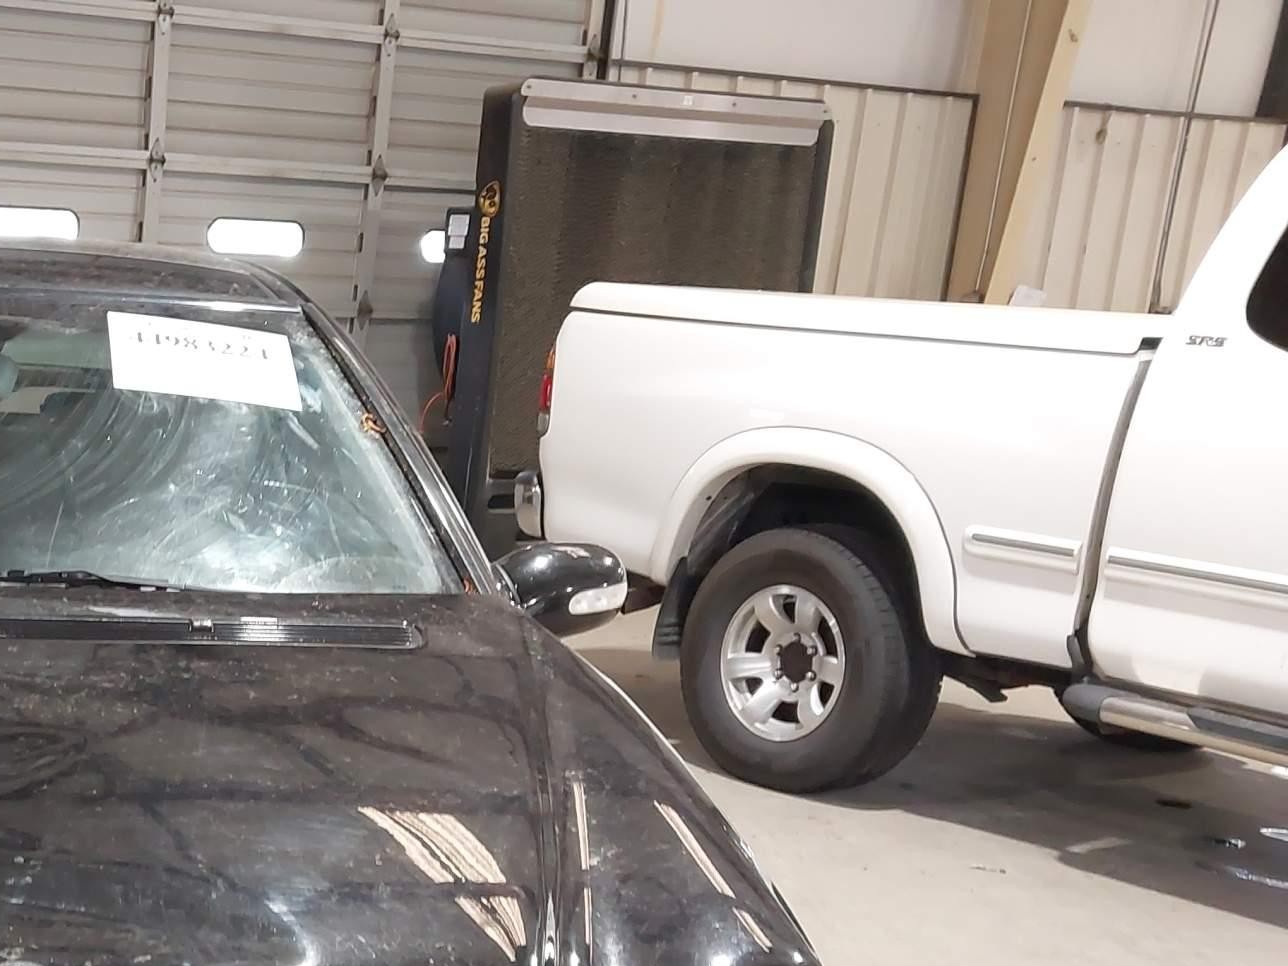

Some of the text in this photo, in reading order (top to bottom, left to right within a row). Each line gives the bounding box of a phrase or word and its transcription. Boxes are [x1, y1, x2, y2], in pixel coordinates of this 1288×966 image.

[471, 216, 491, 324] BIG ASS FANS
